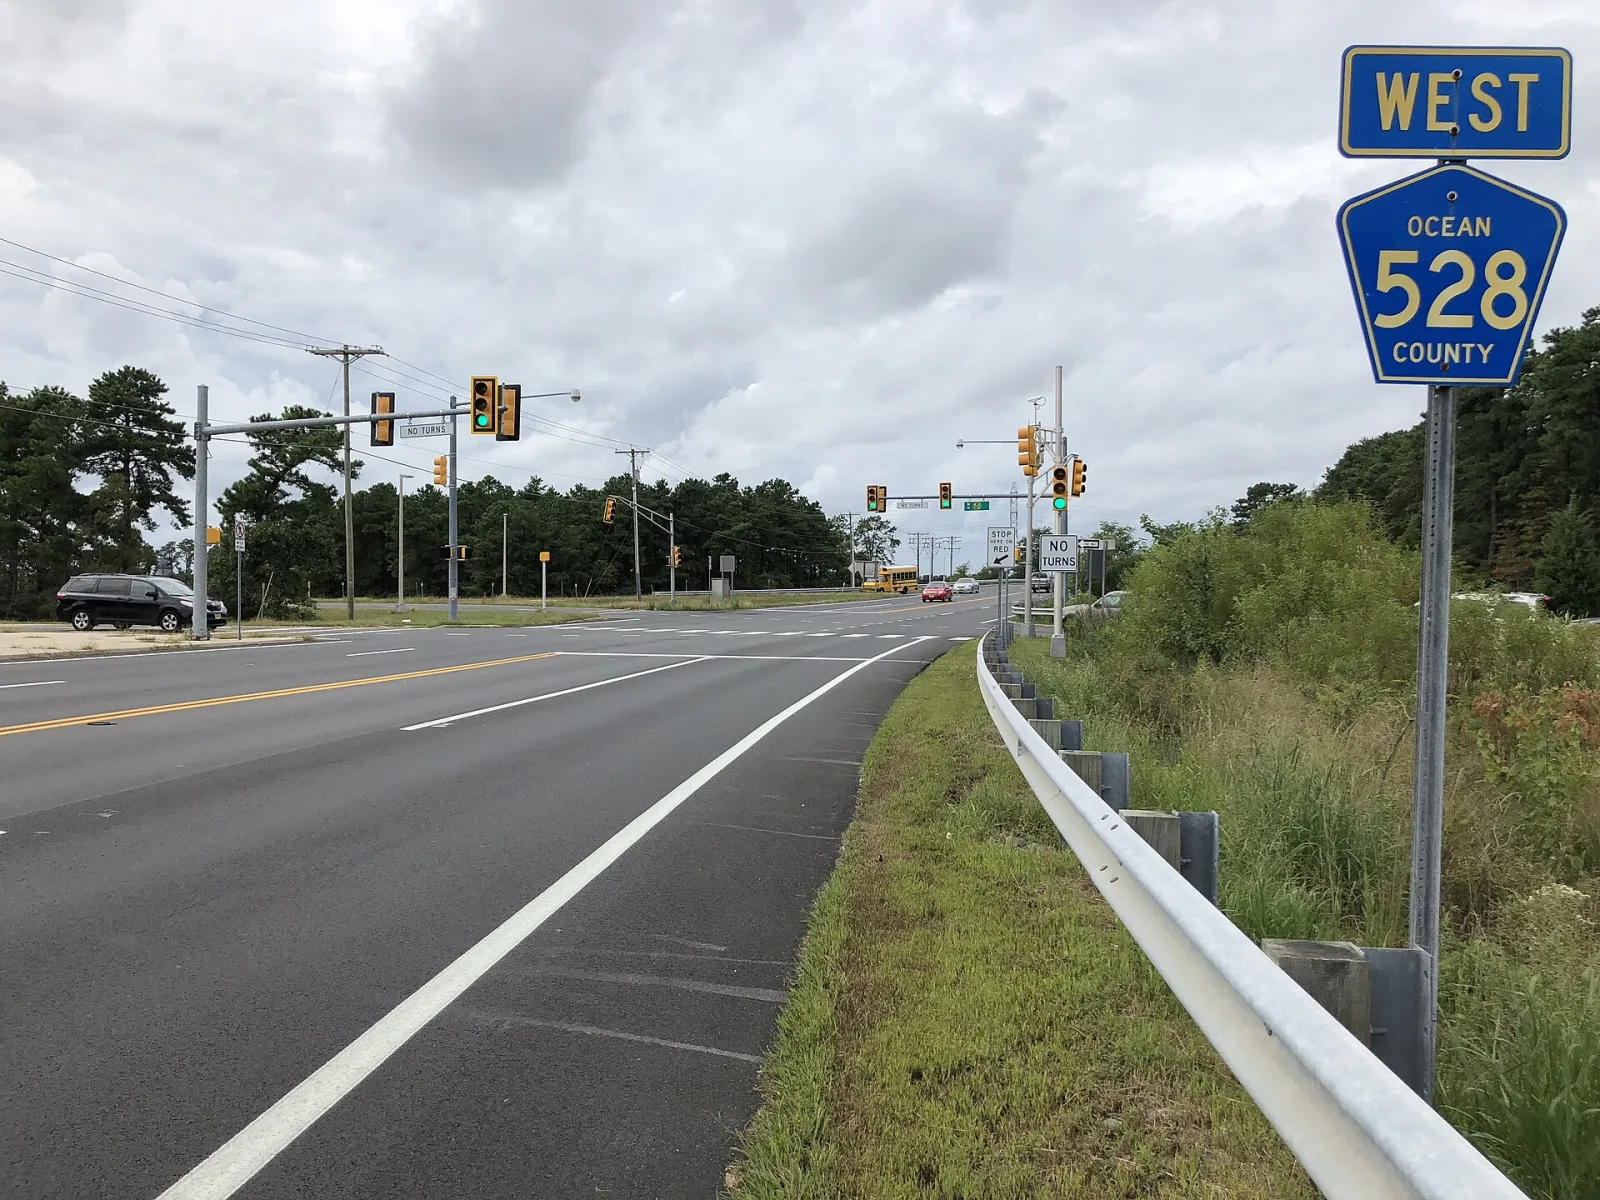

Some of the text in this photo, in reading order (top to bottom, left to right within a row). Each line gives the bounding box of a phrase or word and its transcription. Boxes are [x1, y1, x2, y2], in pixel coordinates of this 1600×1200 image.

[1375, 71, 1539, 133] WEST
[1407, 215, 1491, 237] OCEAN
[1373, 249, 1528, 330] 528
[1392, 341, 1494, 364] COUNTY
[407, 425, 446, 435] NO TURNS
[993, 545, 1009, 553] RED
[1049, 540, 1068, 552] NO
[1042, 556, 1076, 566] TURNS
